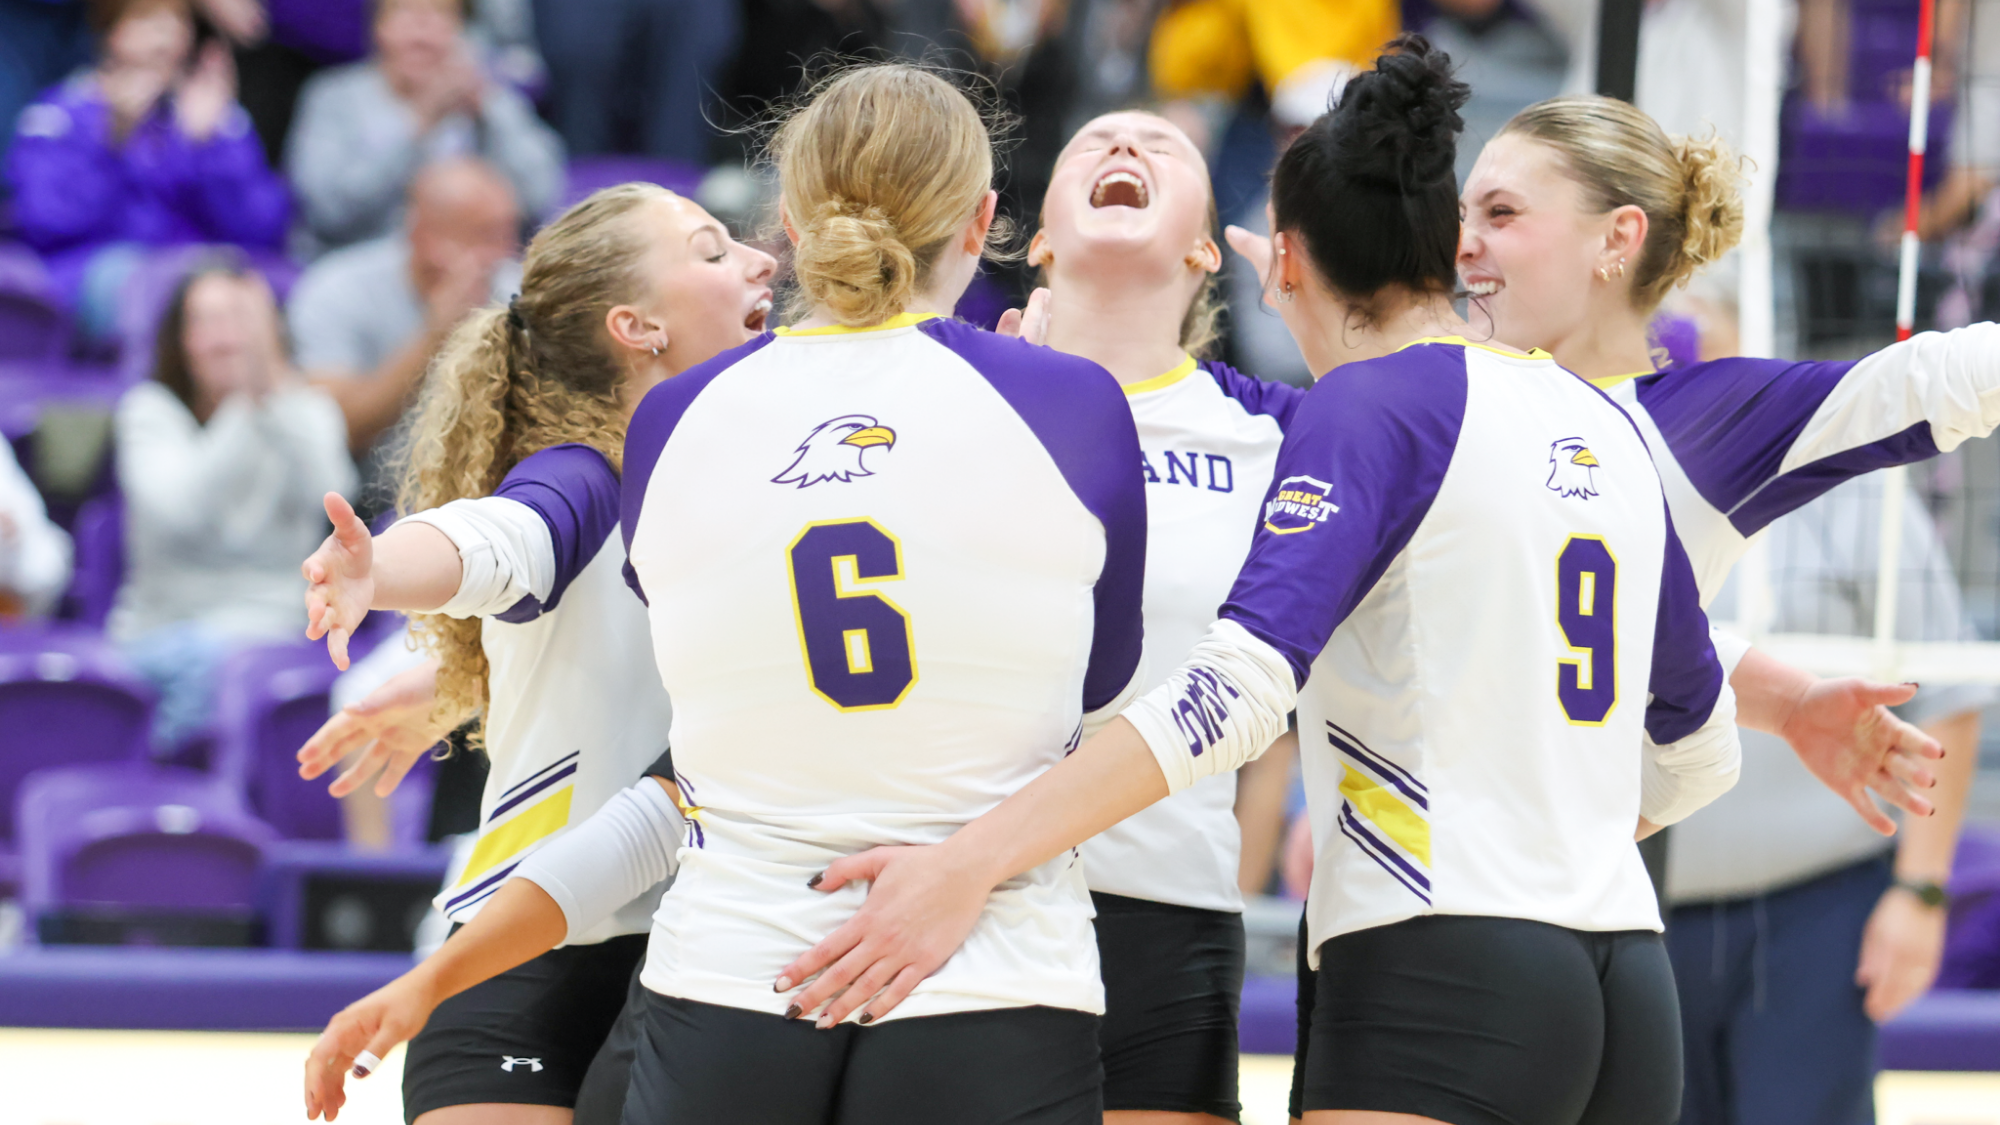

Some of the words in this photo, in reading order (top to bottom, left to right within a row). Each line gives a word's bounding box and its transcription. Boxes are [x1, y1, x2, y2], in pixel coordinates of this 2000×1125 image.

[1263, 497, 1340, 522] MDWEST
[1278, 490, 1323, 506] GREAT
[785, 516, 920, 713] 6
[1555, 532, 1619, 728] 9
